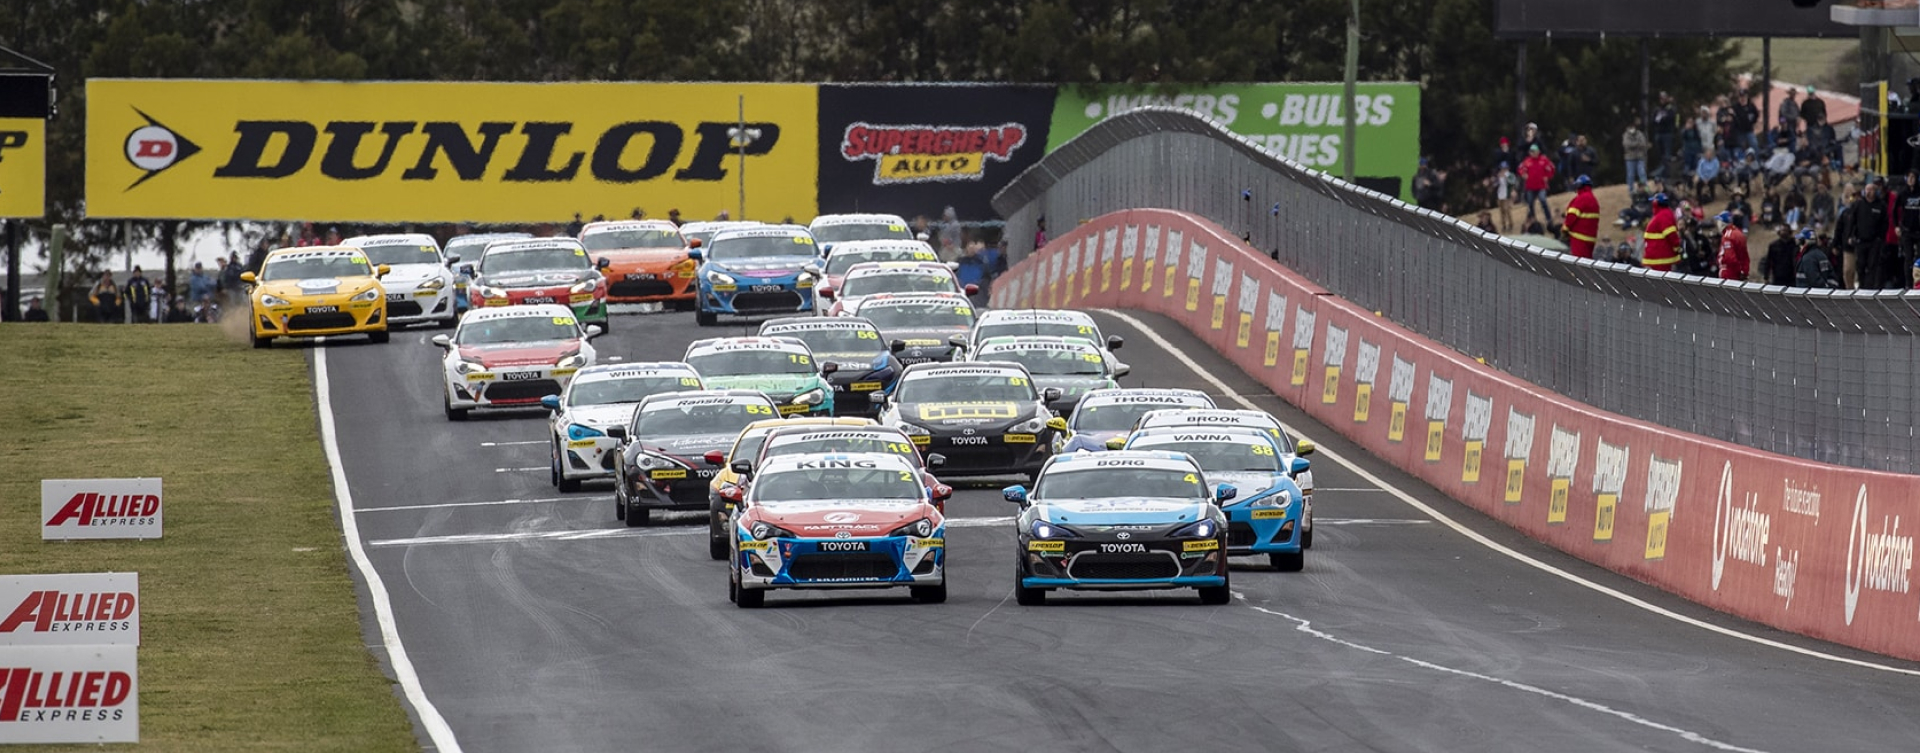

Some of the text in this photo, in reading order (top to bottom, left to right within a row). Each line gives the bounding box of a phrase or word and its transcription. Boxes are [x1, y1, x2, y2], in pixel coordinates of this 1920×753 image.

[842, 124, 1025, 158] SUPERCHEAP
[213, 120, 780, 182] DUNLOP
[892, 157, 970, 174] AUTO
[625, 272, 657, 280] TOYOTA
[306, 306, 337, 314] TOYOTA
[478, 311, 552, 319] BRIGHT
[771, 322, 867, 332] BAXTER-SMITH
[993, 343, 1086, 352] GUTIERREZ
[506, 372, 539, 380] TOYOTA
[677, 397, 734, 406] Ransley
[1114, 396, 1185, 405] THOMAS
[1186, 415, 1241, 424] BROOK
[801, 432, 881, 441] GIBBONS
[951, 436, 988, 445] TOYOTA
[1173, 434, 1233, 442] VANNA
[888, 442, 913, 453] 18
[1251, 444, 1275, 456] 38
[796, 460, 877, 469] KING
[1096, 459, 1146, 467] BORG
[899, 471, 914, 482] 2
[1183, 473, 1200, 484] 4
[46, 493, 160, 526] ALLIED
[92, 517, 155, 526] EXPRESS
[1729, 491, 1770, 567] vodafone
[820, 542, 867, 552] TOYOTA
[1100, 543, 1147, 553] TOYOTA
[1865, 514, 1913, 594] vodafone
[0, 590, 135, 632] ALLIED
[51, 621, 129, 632] EXPRESS
[20, 709, 124, 722] EXPRESS
